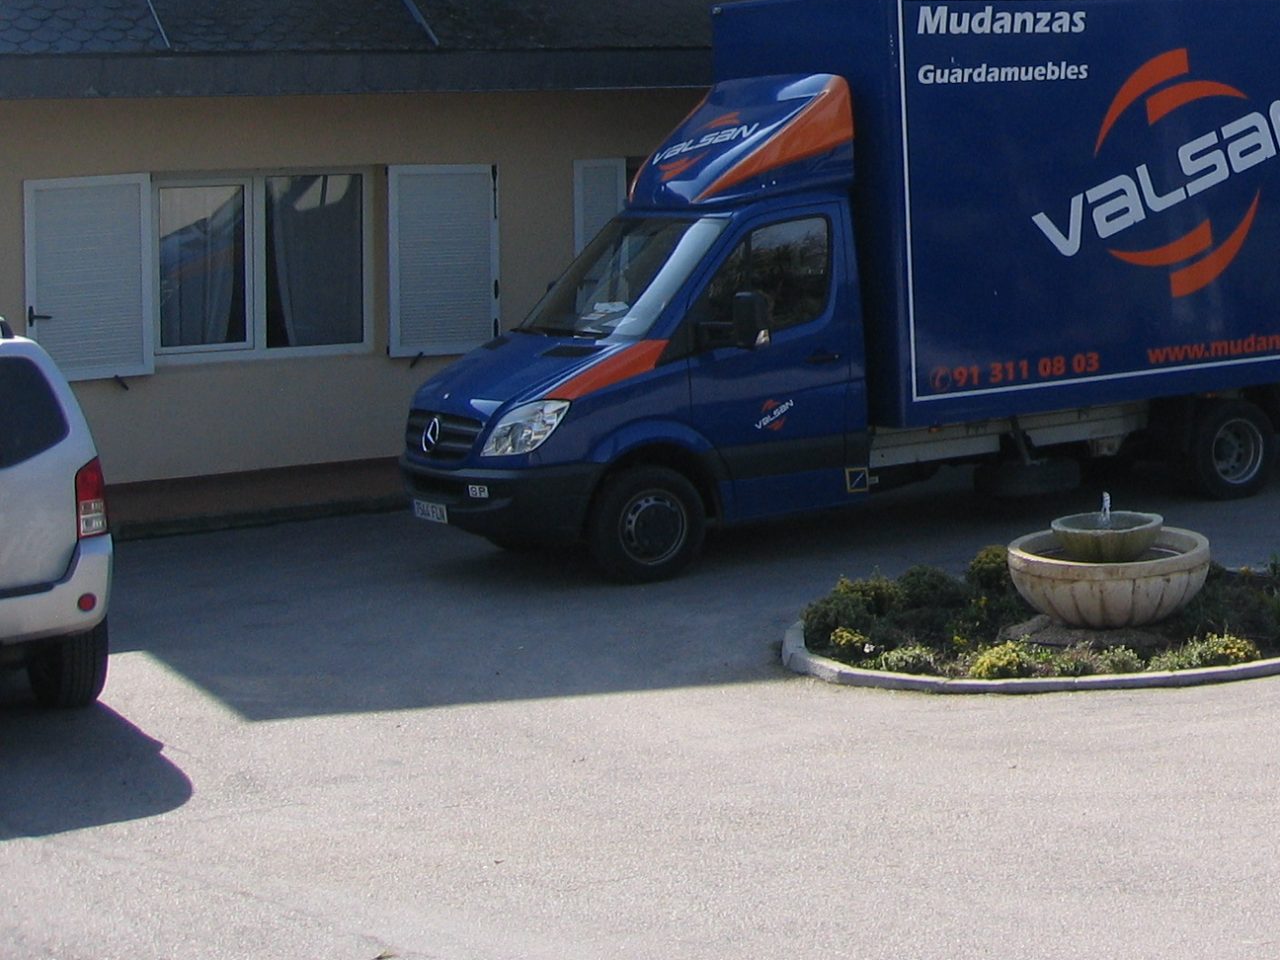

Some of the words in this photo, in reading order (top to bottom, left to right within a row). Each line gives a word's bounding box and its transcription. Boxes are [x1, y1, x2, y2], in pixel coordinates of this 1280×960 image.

[917, 5, 1087, 35] Mudanzas
[917, 61, 1089, 85] Guardamuebles
[953, 365, 981, 387] 91
[990, 359, 1029, 384] 311
[1038, 355, 1066, 377] 08
[1072, 351, 1100, 373] 03
